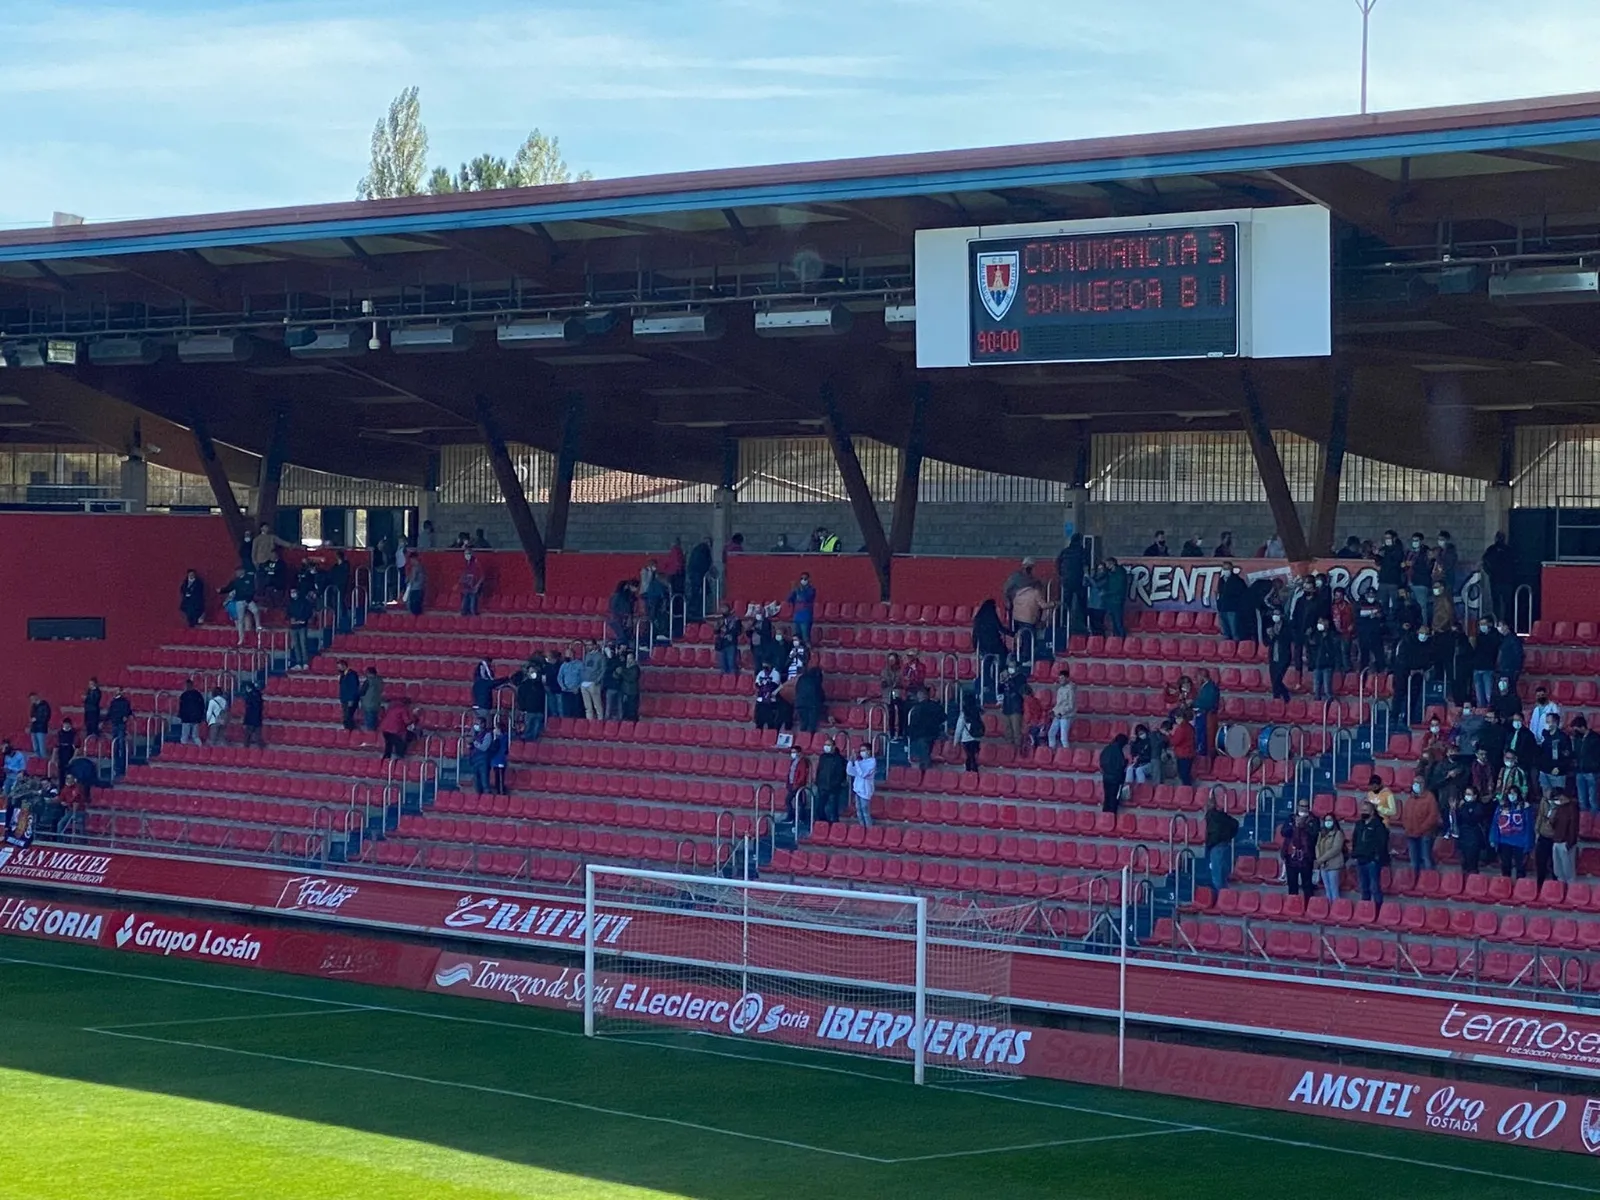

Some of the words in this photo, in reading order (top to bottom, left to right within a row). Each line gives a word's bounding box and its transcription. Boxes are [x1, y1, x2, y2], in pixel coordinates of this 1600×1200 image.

[1208, 231, 1225, 264] 3
[1025, 278, 1162, 315] SDHUESCA
[1219, 275, 1226, 306] 1
[978, 330, 1019, 353] 90:00
[1123, 564, 1223, 607] RENT
[11, 847, 49, 867] SAN
[44, 852, 112, 875] MIGUEL
[135, 921, 197, 956] Grupo
[199, 929, 261, 961] Losán
[471, 960, 546, 1003] Torrezno
[544, 968, 569, 999] de
[614, 983, 730, 1023] E.Leclerc
[757, 1004, 811, 1034] Soria
[1441, 1003, 1600, 1053] termose
[816, 1005, 1033, 1066] IBERPUERTAS
[1425, 1086, 1486, 1121] Oro
[1425, 1115, 1479, 1133] TOSTADA
